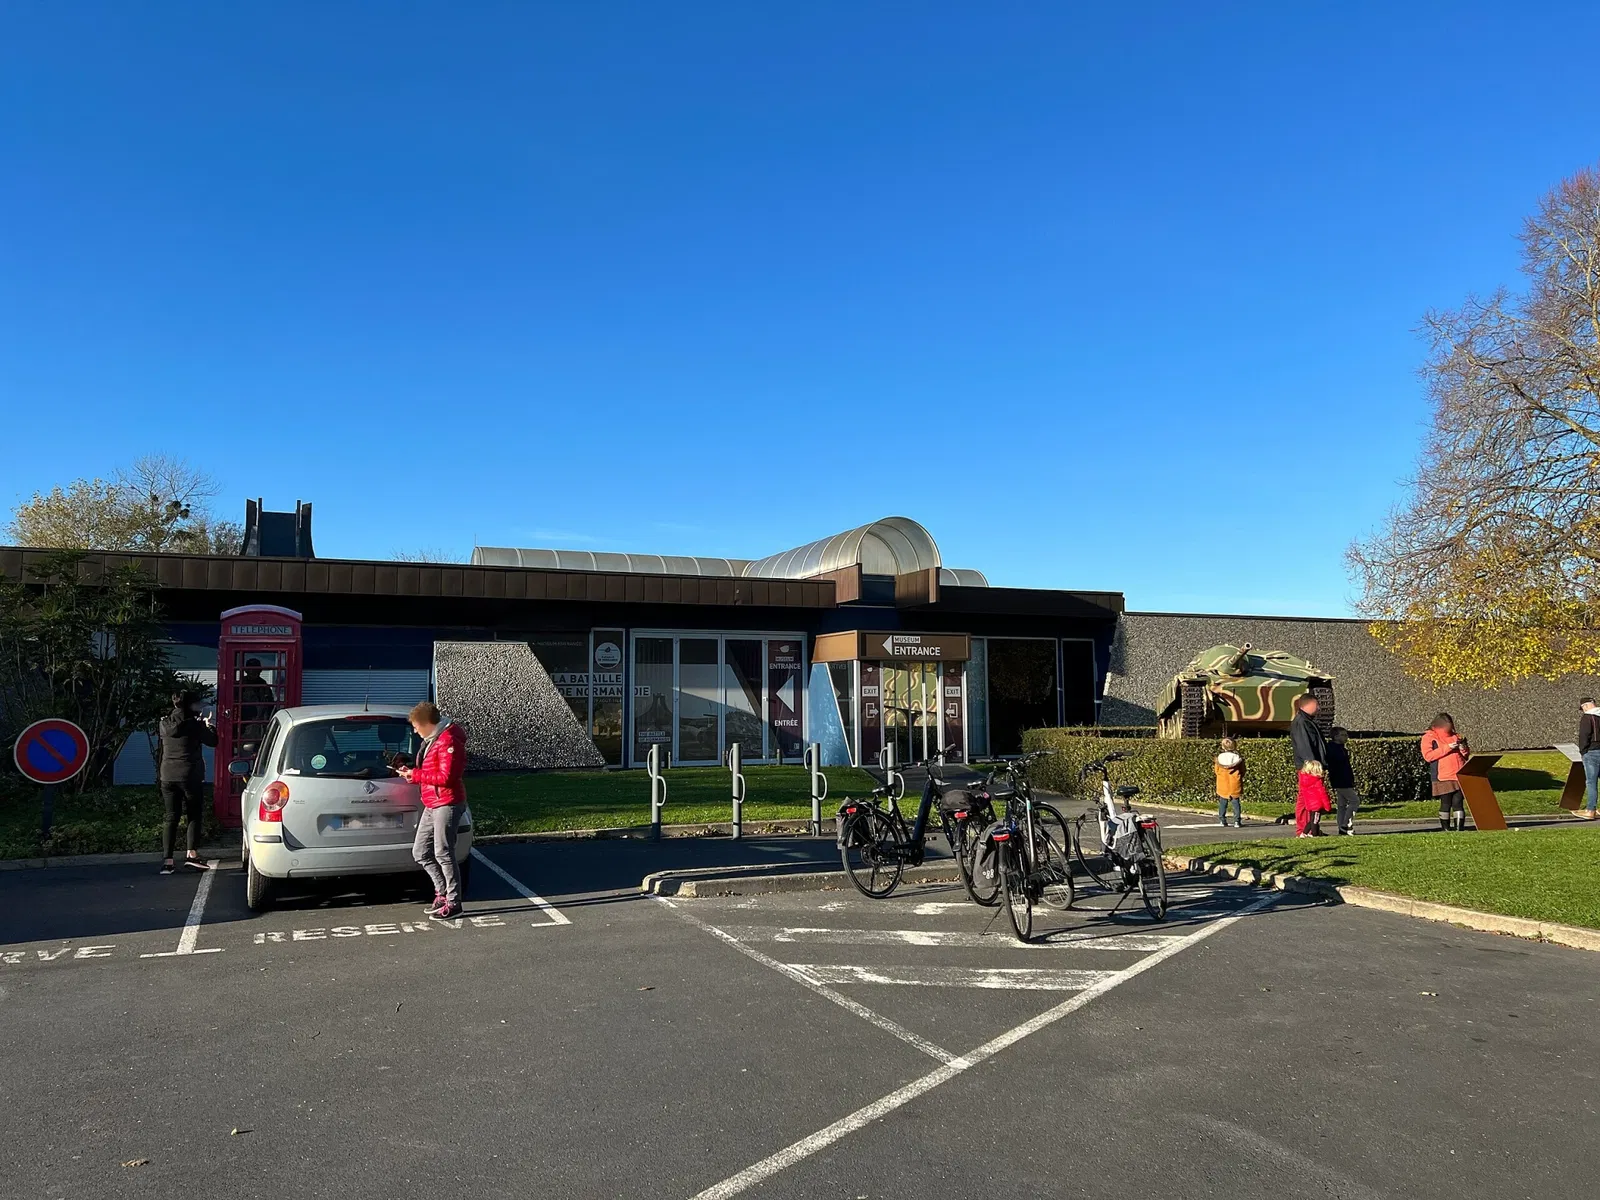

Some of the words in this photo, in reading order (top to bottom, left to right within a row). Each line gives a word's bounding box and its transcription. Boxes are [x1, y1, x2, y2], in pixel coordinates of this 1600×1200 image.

[234, 625, 289, 635] TELEPHONE
[894, 646, 941, 656] ENTRANCE
[552, 674, 567, 684] LA
[570, 674, 622, 684] BATAILLE
[558, 687, 573, 697] DE
[576, 687, 650, 697] NORMANDIE
[774, 718, 799, 727] ENTRÉE
[253, 915, 506, 945] RESERVE
